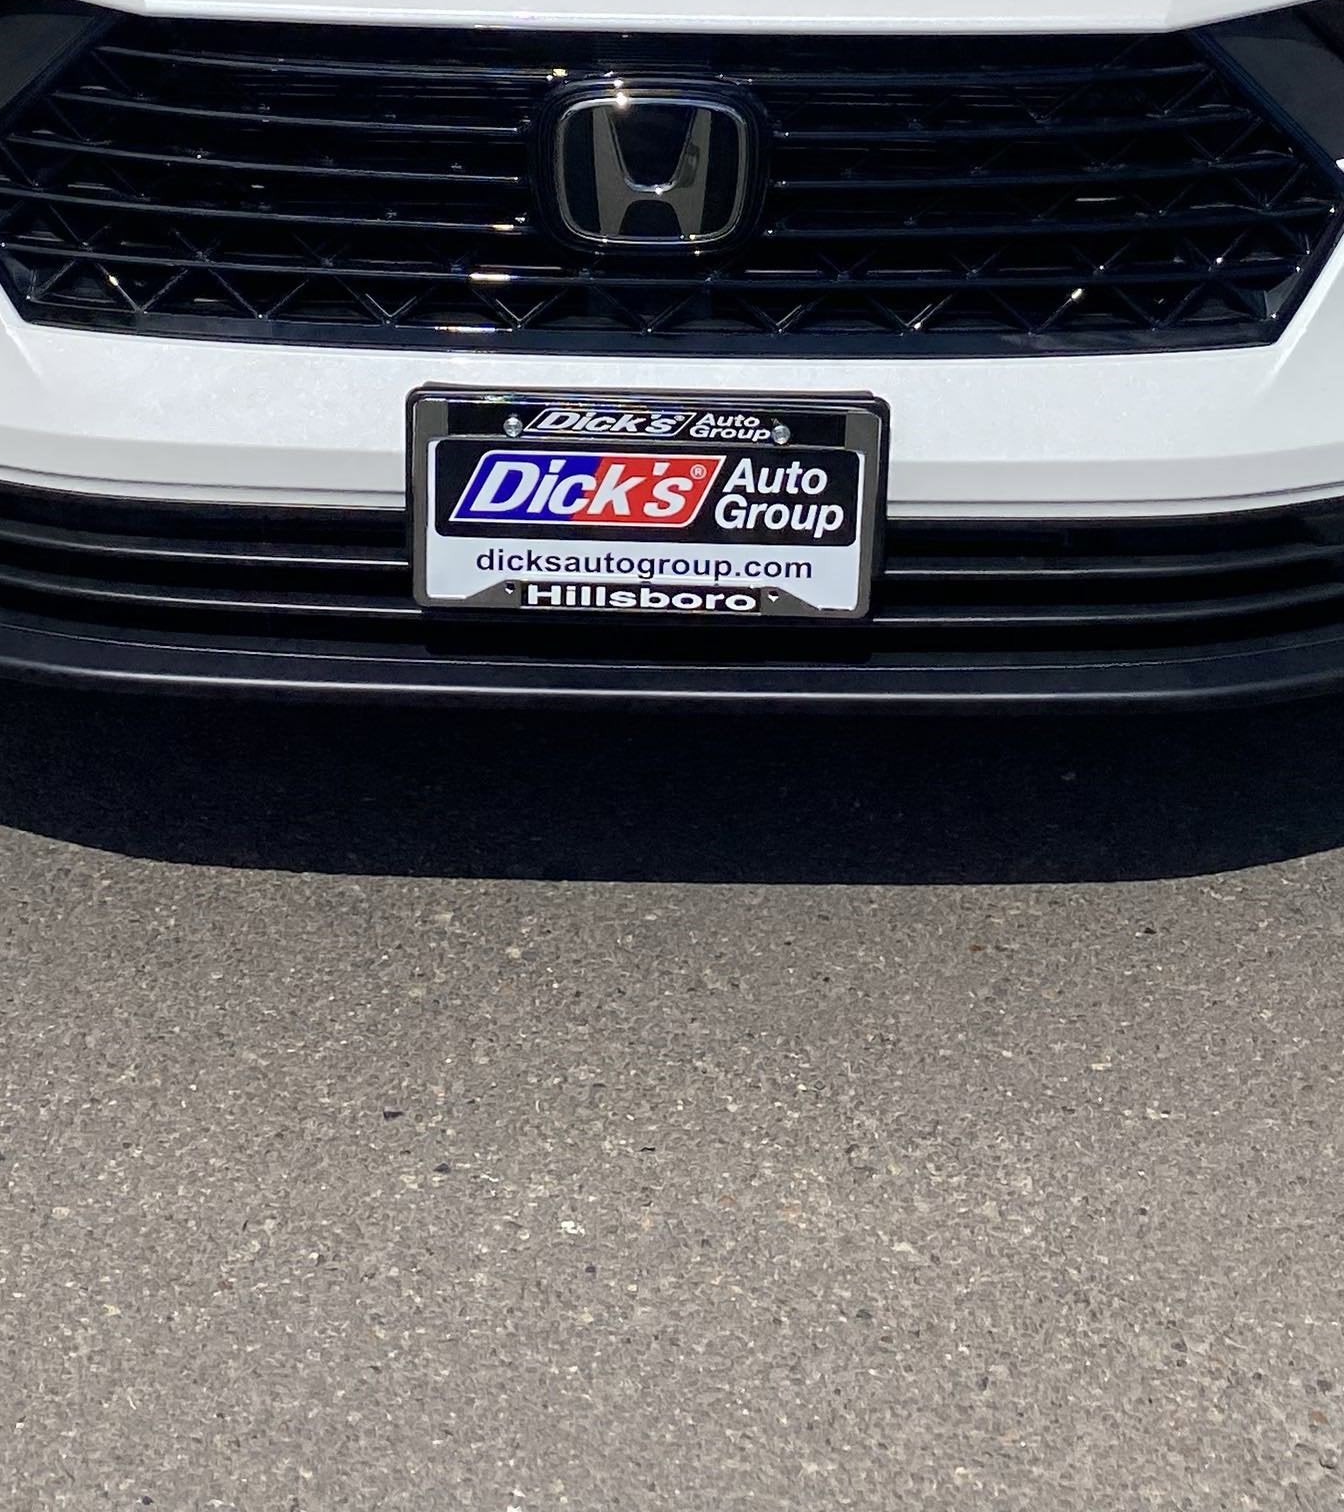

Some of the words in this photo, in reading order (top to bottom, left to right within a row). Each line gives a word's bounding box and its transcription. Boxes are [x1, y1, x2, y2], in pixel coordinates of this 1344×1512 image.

[689, 426, 771, 441] Group
[696, 413, 761, 427] Auto
[470, 459, 695, 518] Dick's
[722, 458, 829, 496] Auto
[713, 495, 845, 539] Group
[475, 548, 813, 581] dicksautogroup.com
[527, 584, 757, 612] Hillsboro
